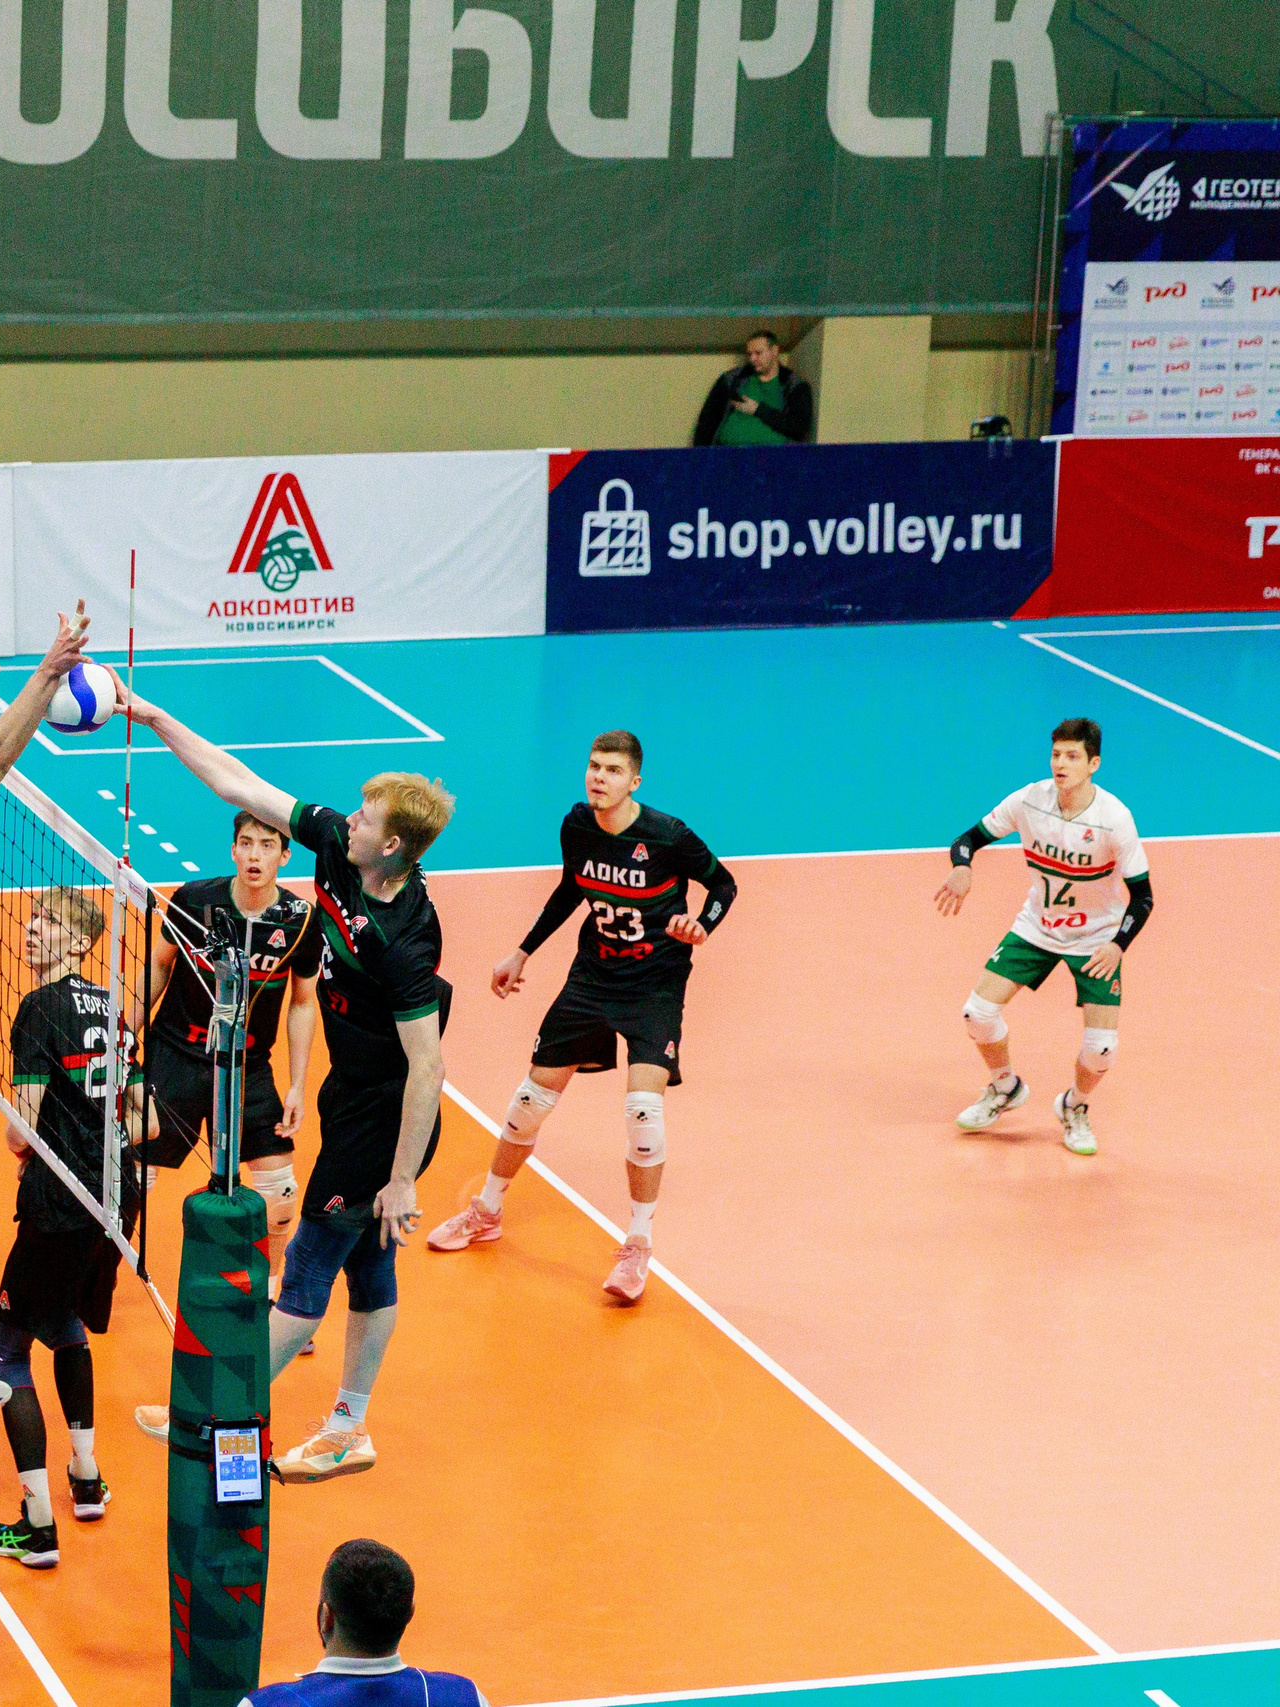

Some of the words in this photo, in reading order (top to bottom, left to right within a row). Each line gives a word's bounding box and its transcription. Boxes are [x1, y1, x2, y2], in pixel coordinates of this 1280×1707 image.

[1210, 178, 1280, 198] ГЕОТЕ
[667, 502, 1022, 569] shop.volley.ru
[207, 596, 355, 618] ЛОКОМОТИВ
[225, 618, 336, 633] НОВОСИБИРСК
[1032, 839, 1092, 866] ЛОКО
[581, 859, 647, 888] ЛОКО
[1042, 876, 1075, 908] 14
[592, 900, 645, 942] 23
